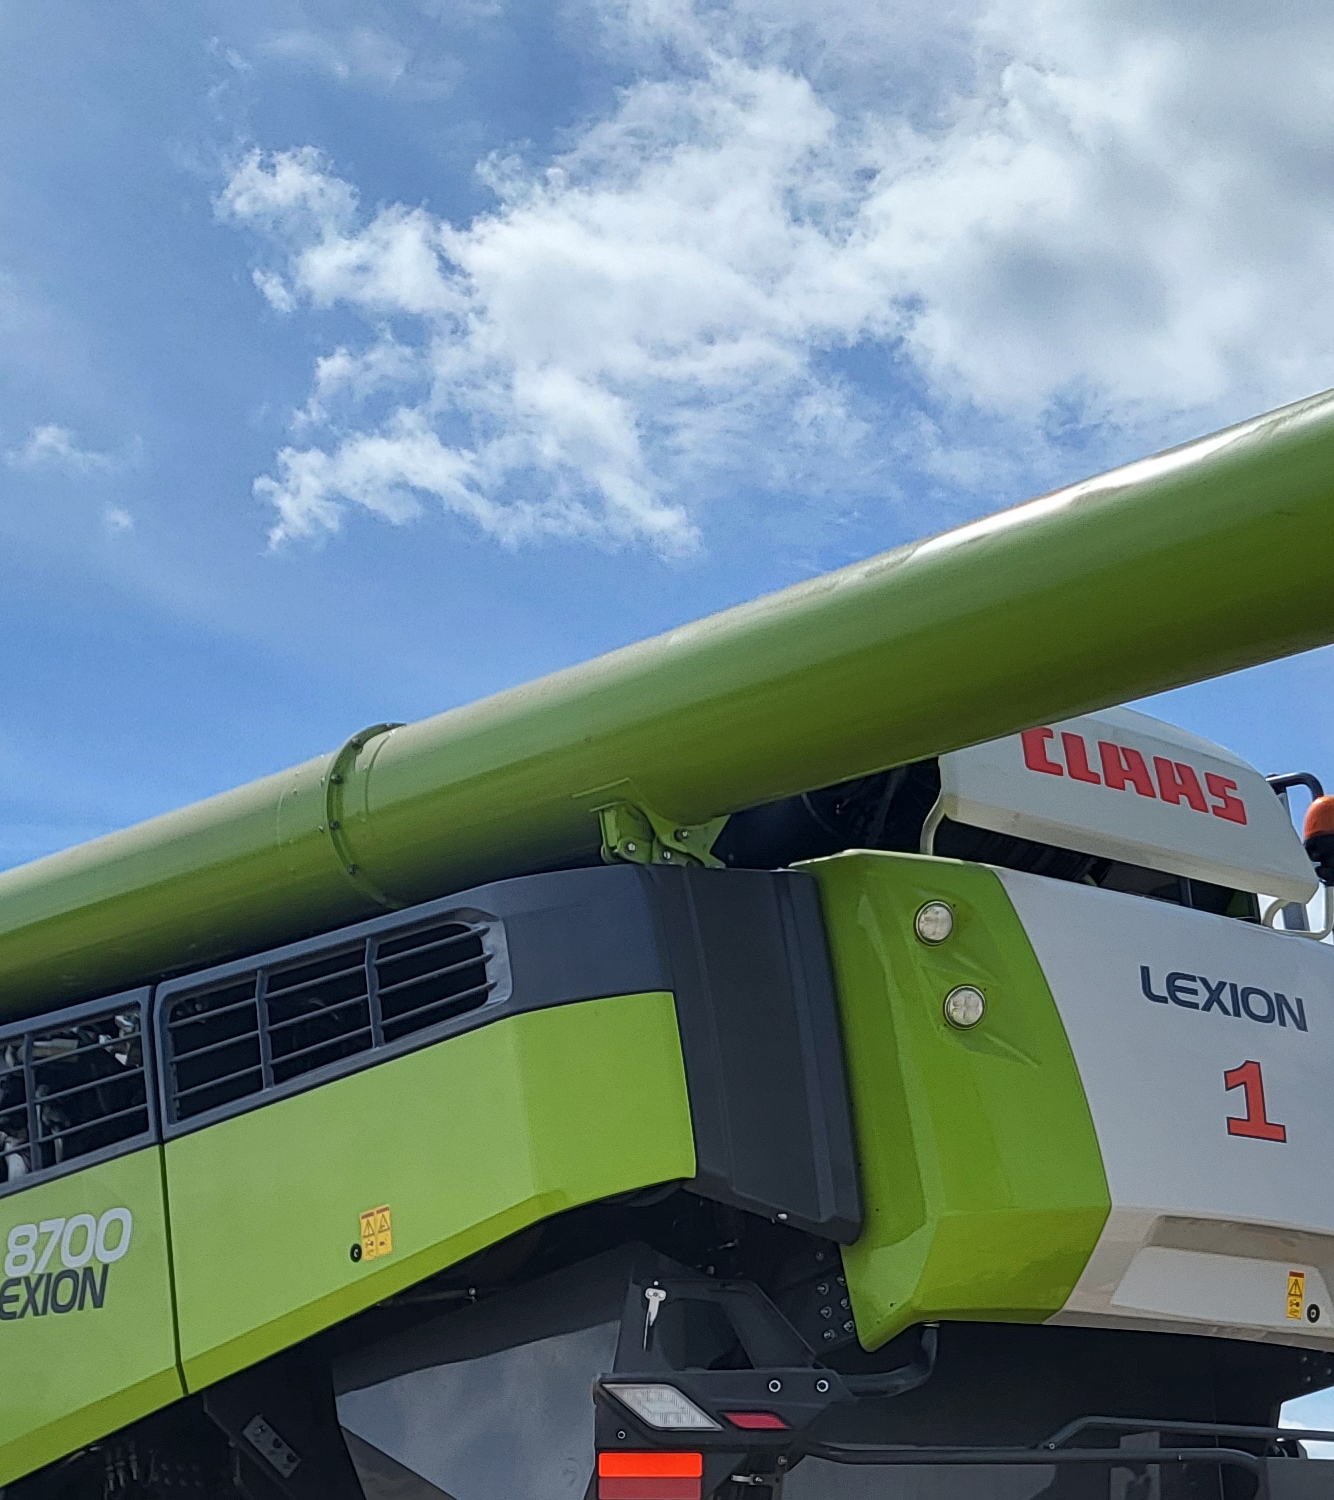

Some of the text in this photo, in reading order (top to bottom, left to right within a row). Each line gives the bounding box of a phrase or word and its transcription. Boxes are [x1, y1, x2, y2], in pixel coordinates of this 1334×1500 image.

[1020, 726, 1248, 825] CLAAS
[1139, 965, 1309, 1033] LEXION
[1223, 1060, 1287, 1143] 1
[4, 1207, 134, 1279] 8700
